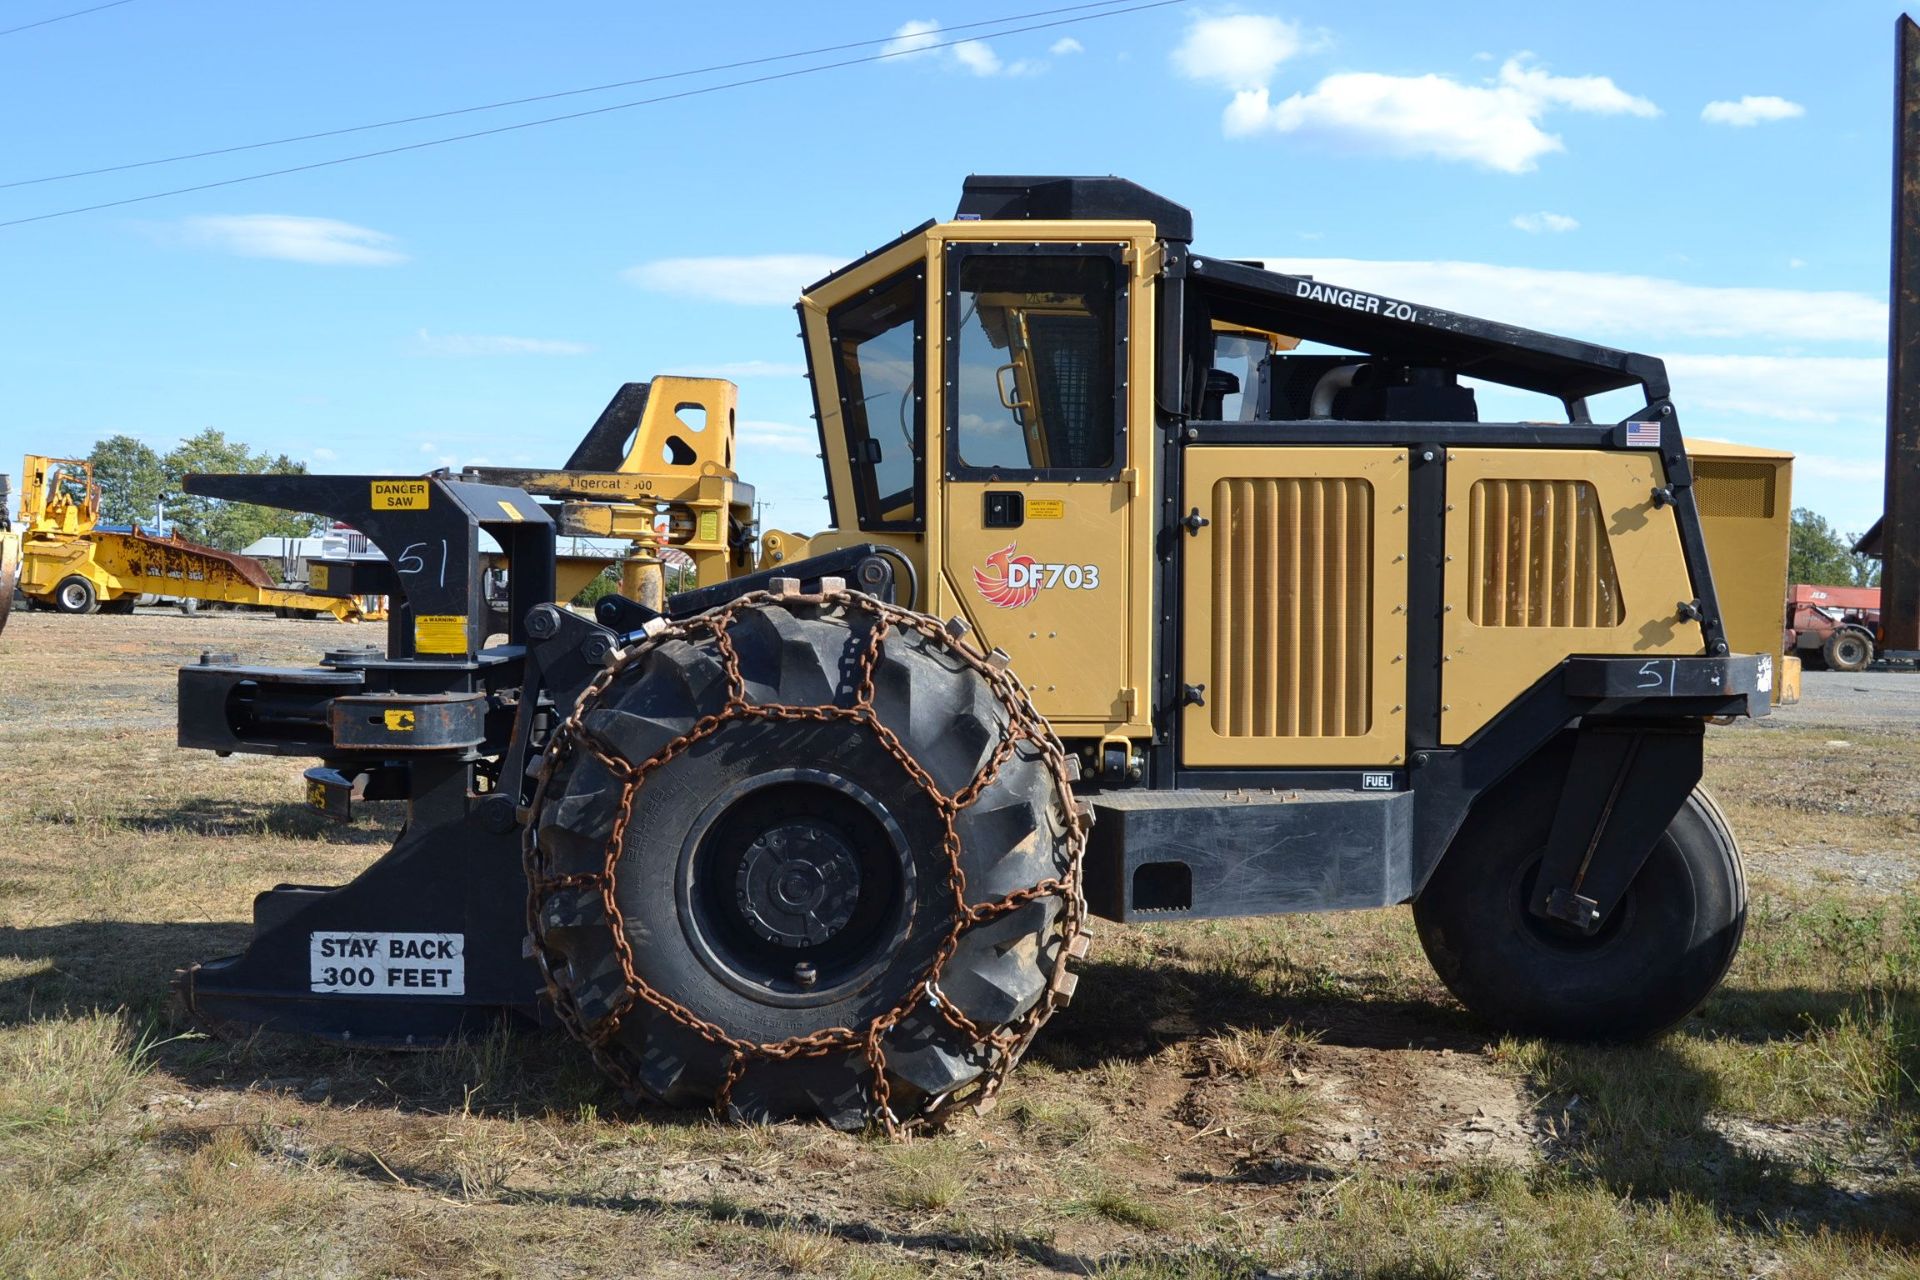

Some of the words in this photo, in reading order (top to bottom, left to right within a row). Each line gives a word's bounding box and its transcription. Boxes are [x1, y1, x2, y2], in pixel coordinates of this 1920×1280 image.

[1296, 281, 1380, 314] DANGER
[375, 484, 425, 494] DANGER
[387, 497, 413, 506] SAW
[1007, 562, 1100, 590] DF703
[1365, 775, 1390, 787] FUEL
[321, 938, 378, 958] STAY
[389, 939, 453, 960] BACK
[323, 966, 375, 987] 300
[387, 967, 453, 988] FEET
